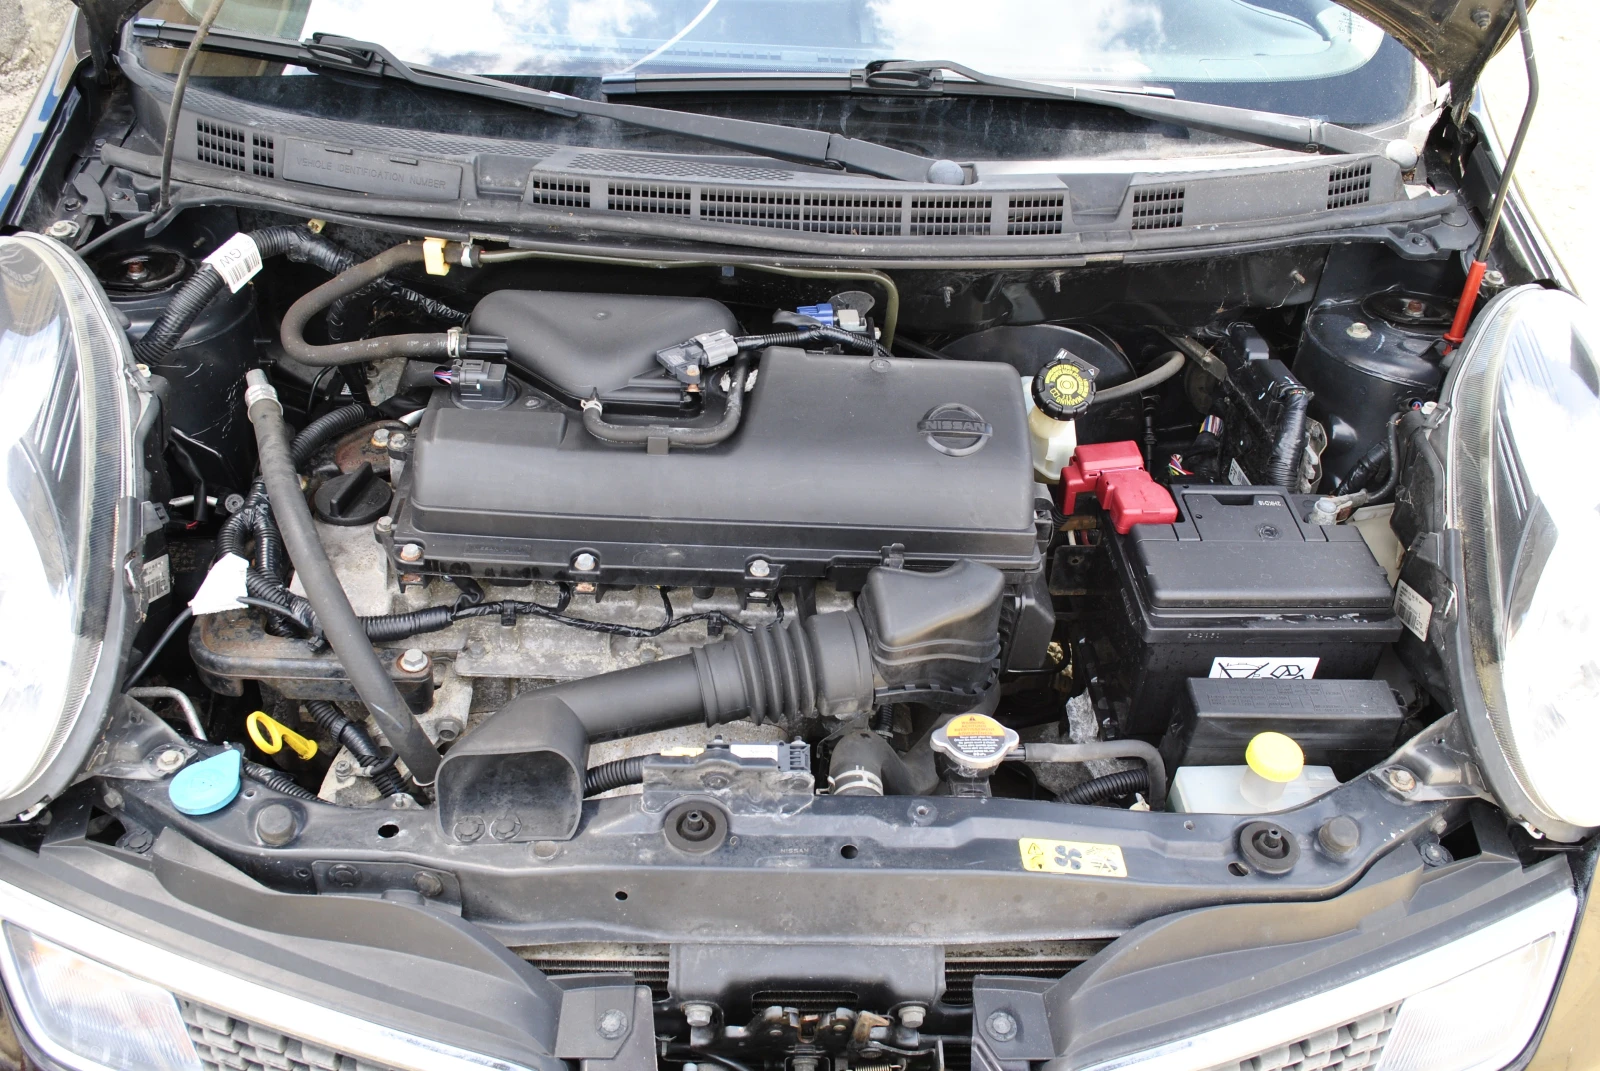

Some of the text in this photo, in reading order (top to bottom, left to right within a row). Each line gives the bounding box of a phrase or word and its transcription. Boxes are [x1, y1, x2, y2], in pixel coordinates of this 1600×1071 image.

[296, 156, 446, 190] VEHICLE IDENTIFICATION NUMBER
[219, 248, 242, 268] GW
[1055, 395, 1085, 406] WARNING
[925, 420, 986, 432] NISSAN
